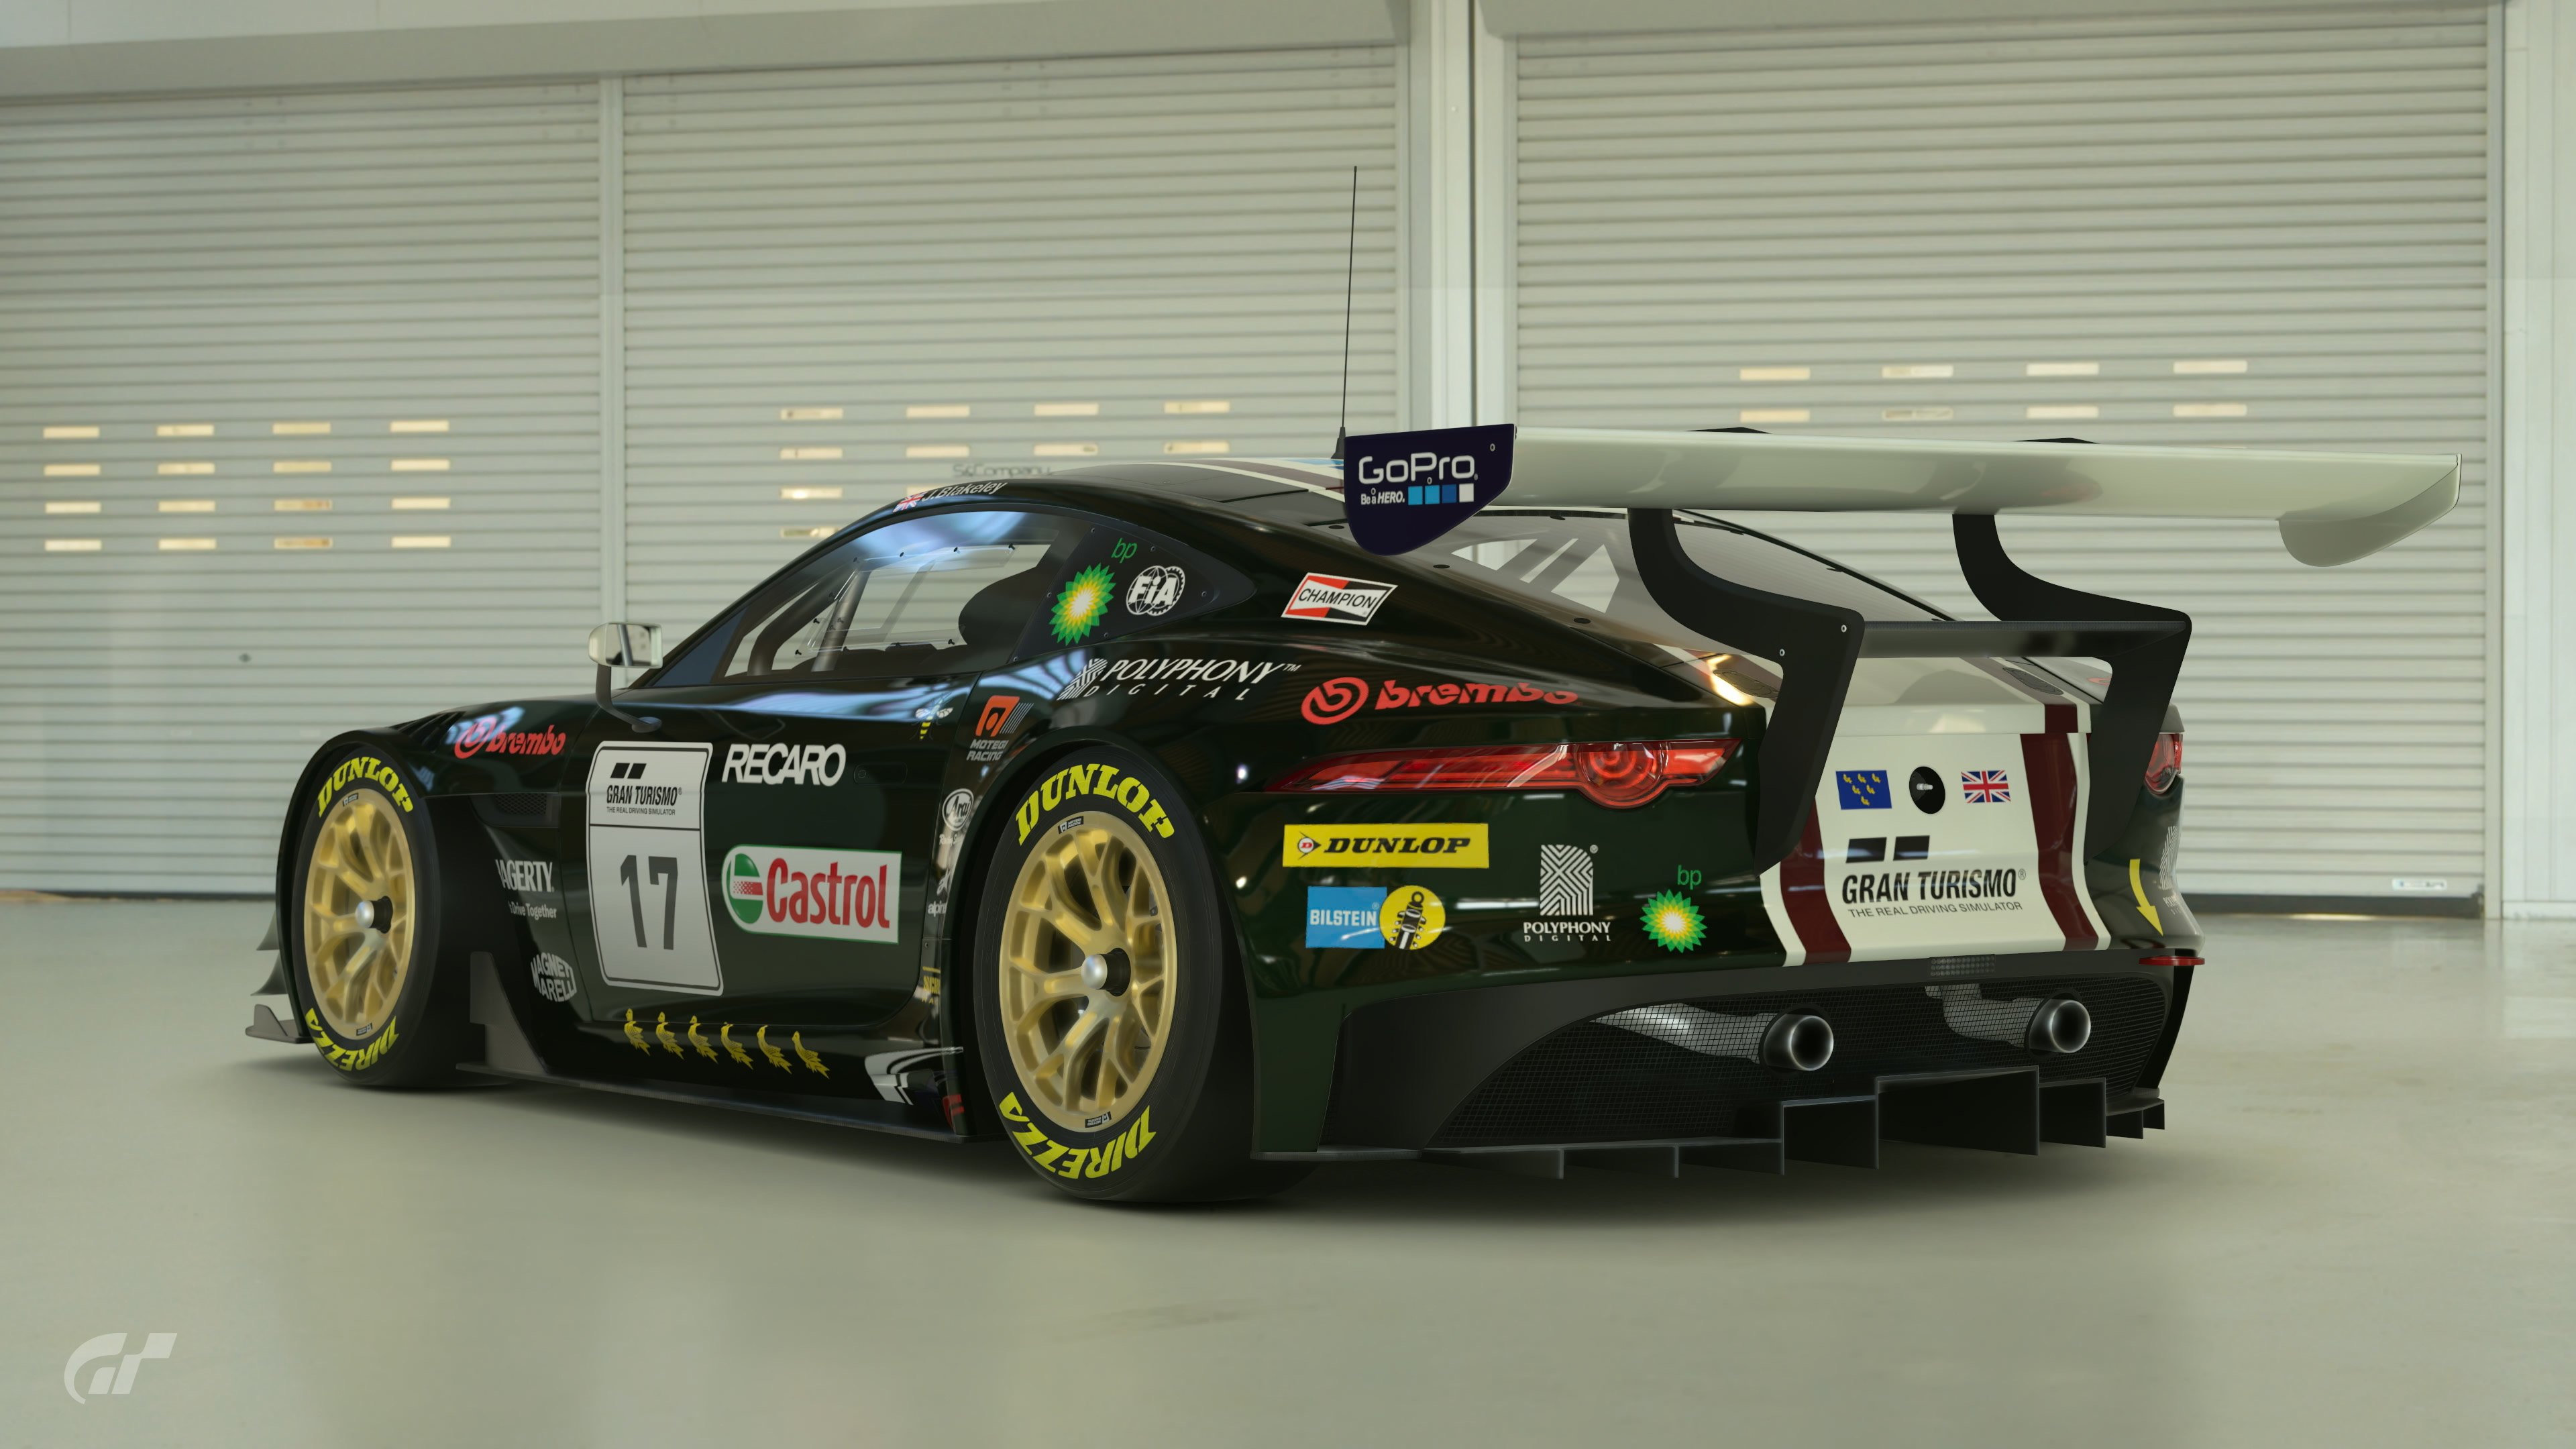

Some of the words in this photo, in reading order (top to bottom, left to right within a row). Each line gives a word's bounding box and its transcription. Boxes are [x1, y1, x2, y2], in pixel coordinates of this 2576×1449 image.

[1358, 452, 1475, 484] GoPro
[1361, 494, 1371, 505] Be
[1372, 495, 1377, 504] a
[1377, 491, 1405, 504] HERO.
[1111, 537, 1137, 564] bp
[1298, 588, 1378, 609] CHAMPION
[1083, 684, 1250, 700] DIGITAL
[1375, 680, 1578, 710] brembo
[485, 724, 566, 755] brembo
[970, 739, 1009, 749] MOTEGI
[722, 743, 846, 787] RECARO
[966, 751, 1004, 761] RACING
[317, 756, 413, 818] DUNLOP
[606, 785, 633, 804] GRAN
[1016, 763, 1175, 846] DUNLOP
[1324, 837, 1470, 853] DUNLOP
[1678, 865, 1702, 890] bp
[1842, 872, 1911, 904] GRAN
[620, 855, 678, 951] 17
[767, 858, 890, 928] Castrol
[525, 903, 557, 920] Together
[1310, 910, 1377, 926] BILSTEIN
[1848, 908, 1874, 918] THE
[1876, 906, 1908, 916] REAL
[1911, 904, 1957, 915] DRIVING
[1959, 902, 2023, 913] SIMULATOR
[1523, 922, 1611, 934] POLYPHONY
[305, 1008, 399, 1071] DIREZZA
[999, 1091, 1157, 1179] DIREZZA
